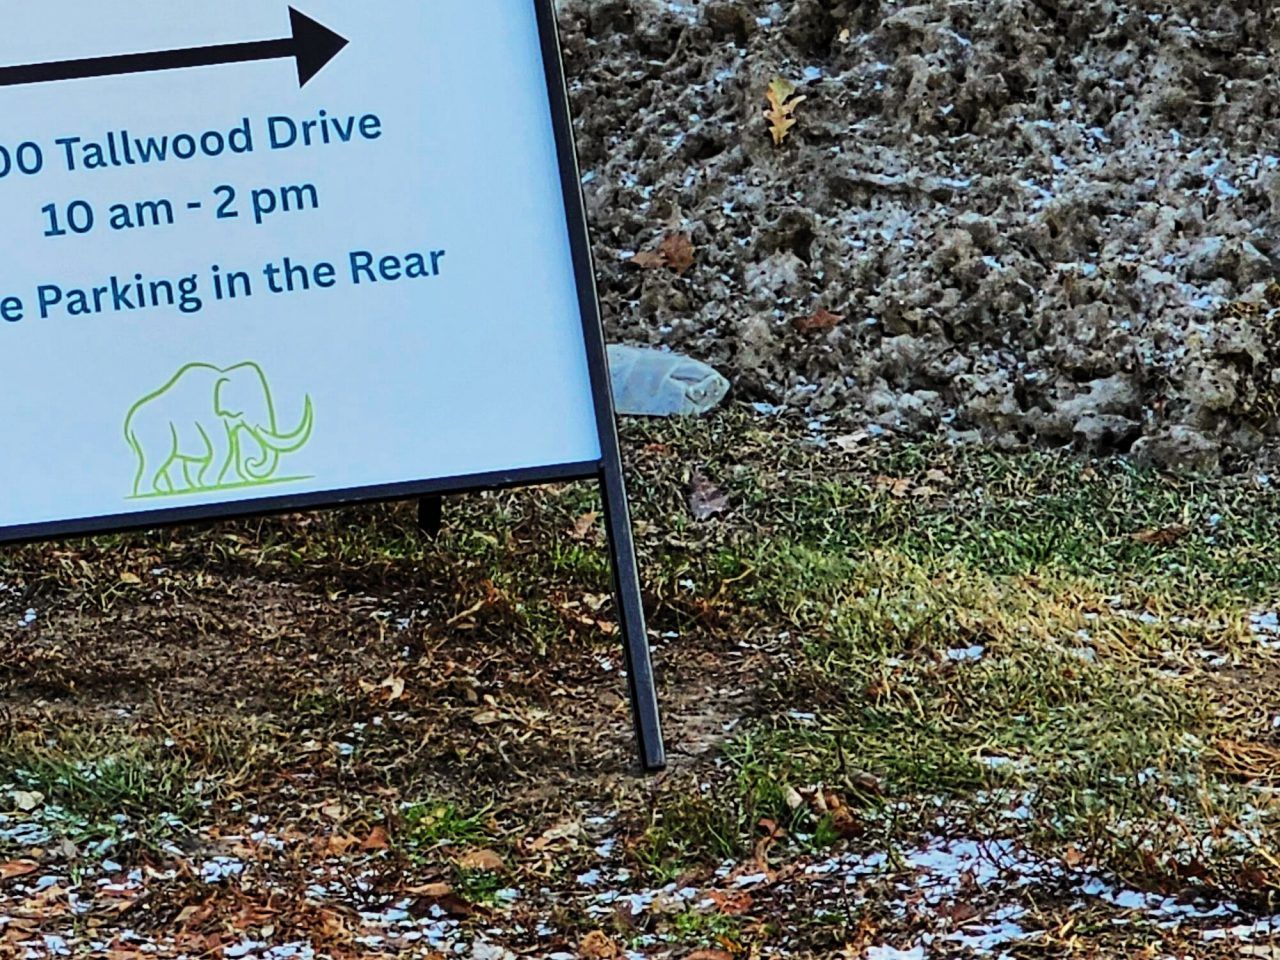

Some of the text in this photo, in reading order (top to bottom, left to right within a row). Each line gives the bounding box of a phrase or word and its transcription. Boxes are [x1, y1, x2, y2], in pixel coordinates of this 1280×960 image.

[55, 118, 254, 172] Tallwood
[267, 109, 383, 149] Drive
[41, 200, 94, 237] 10
[109, 197, 175, 230] am
[215, 184, 239, 219] 2
[251, 182, 320, 224] pm
[37, 273, 203, 314] Parking
[212, 265, 251, 300] in
[263, 256, 336, 292] the
[349, 248, 446, 285] Rear
